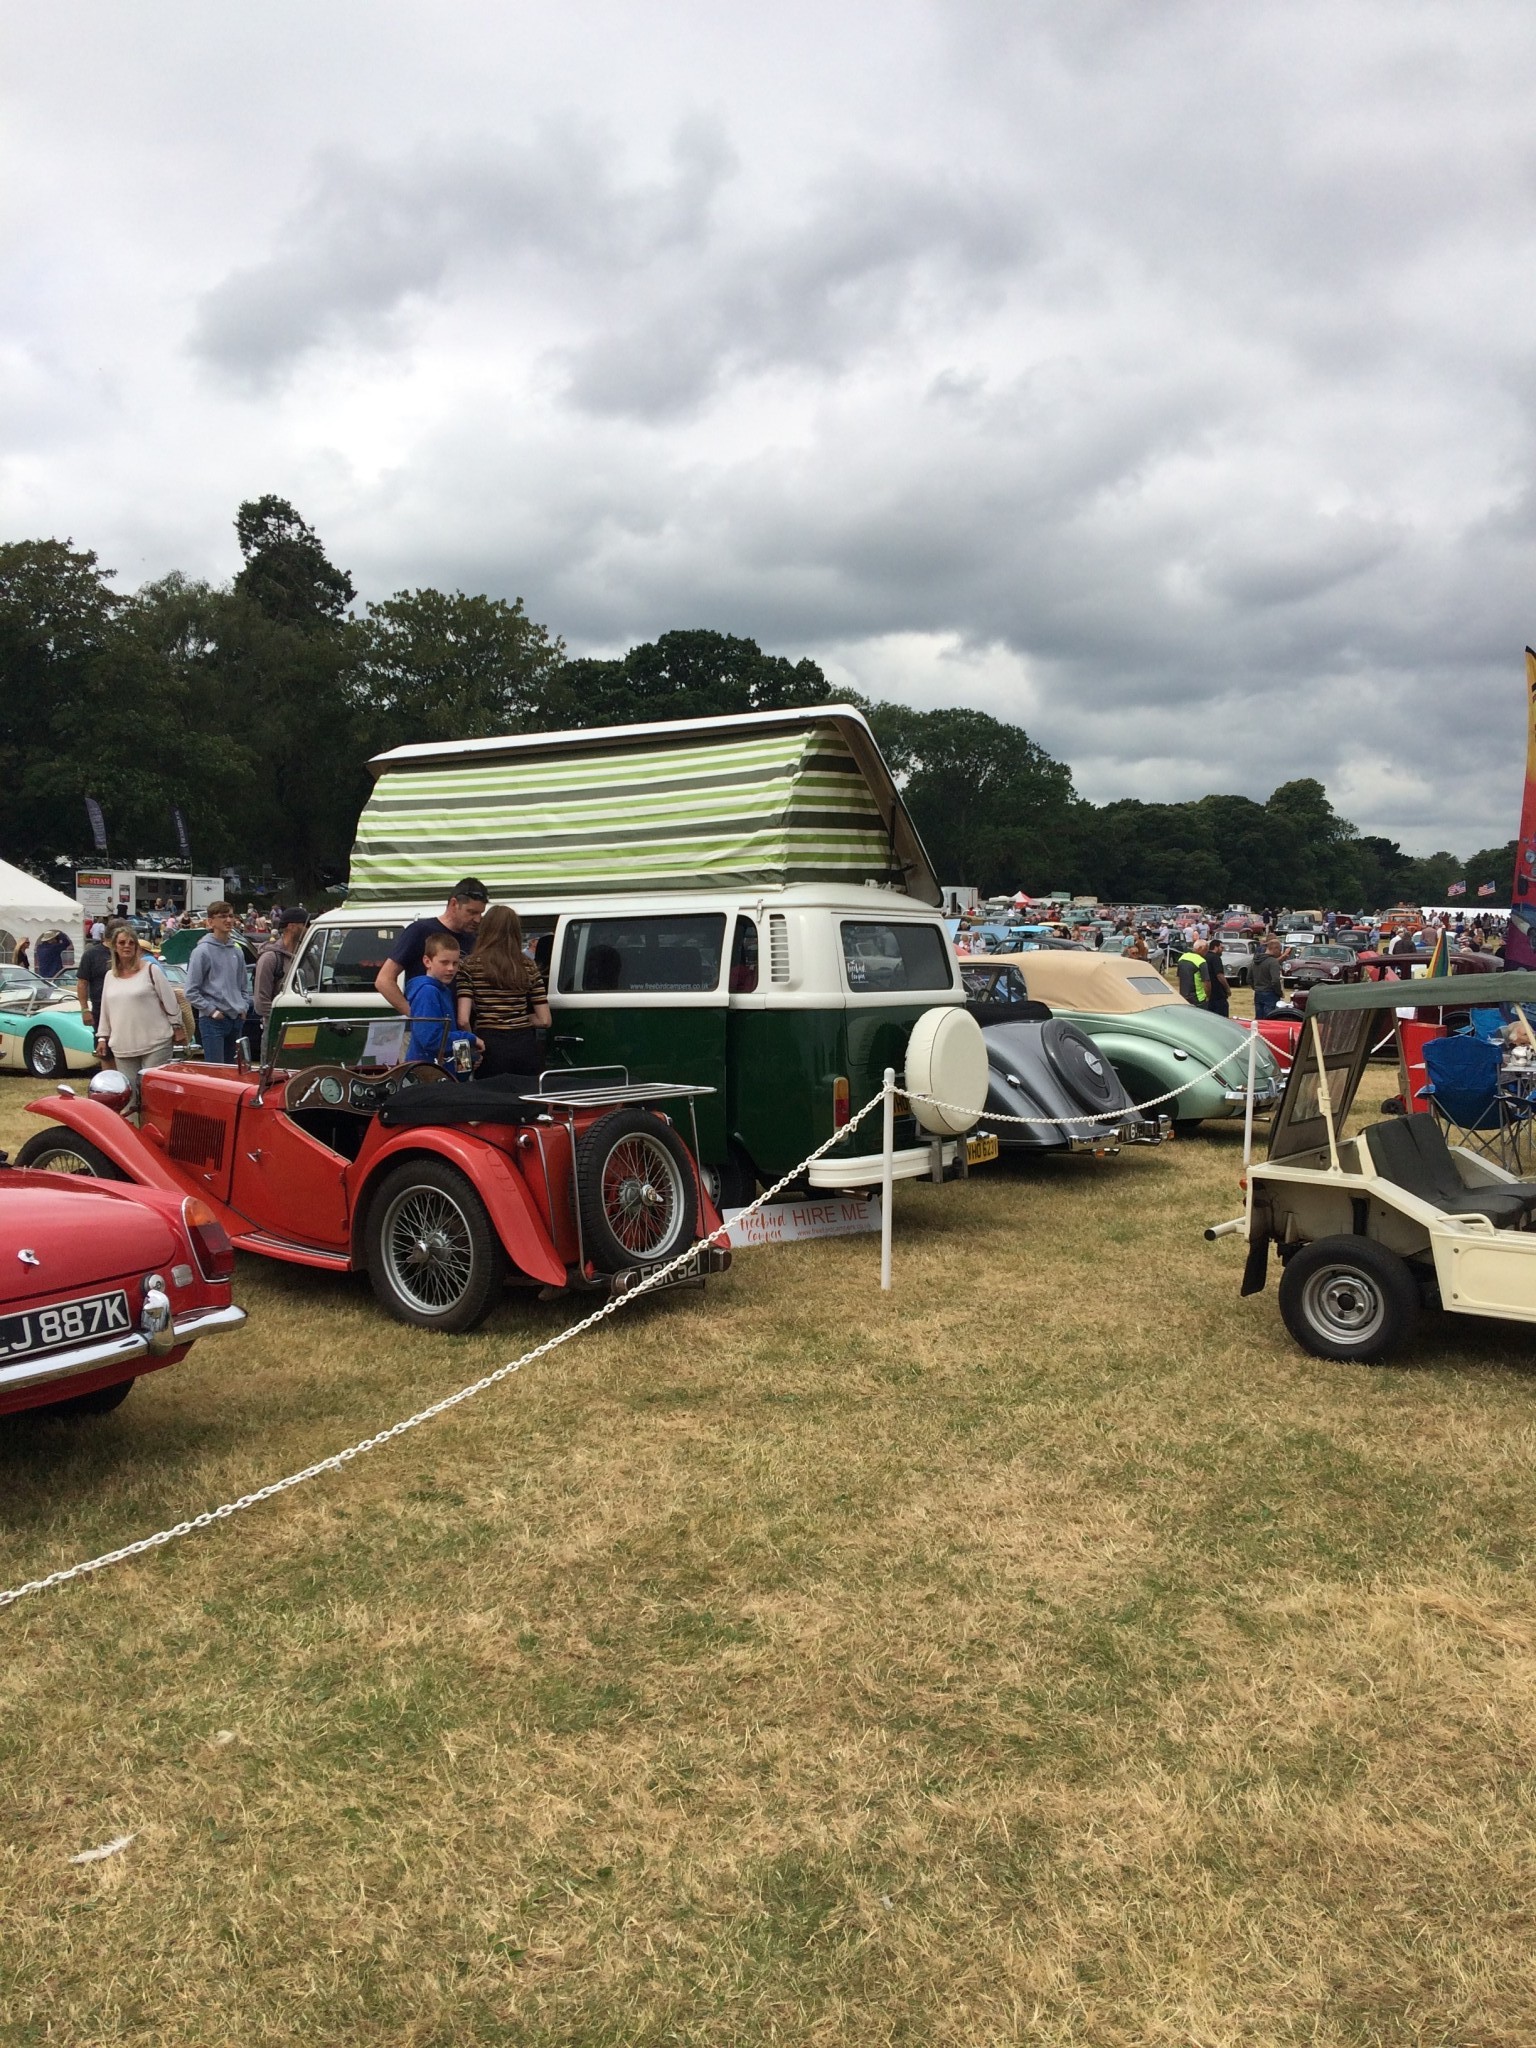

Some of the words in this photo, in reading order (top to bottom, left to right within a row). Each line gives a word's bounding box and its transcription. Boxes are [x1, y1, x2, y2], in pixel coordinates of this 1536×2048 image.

[792, 1205, 837, 1227] HIRE
[841, 1202, 869, 1221] ME
[677, 1254, 701, 1279] 521
[39, 1295, 127, 1344] 887K
